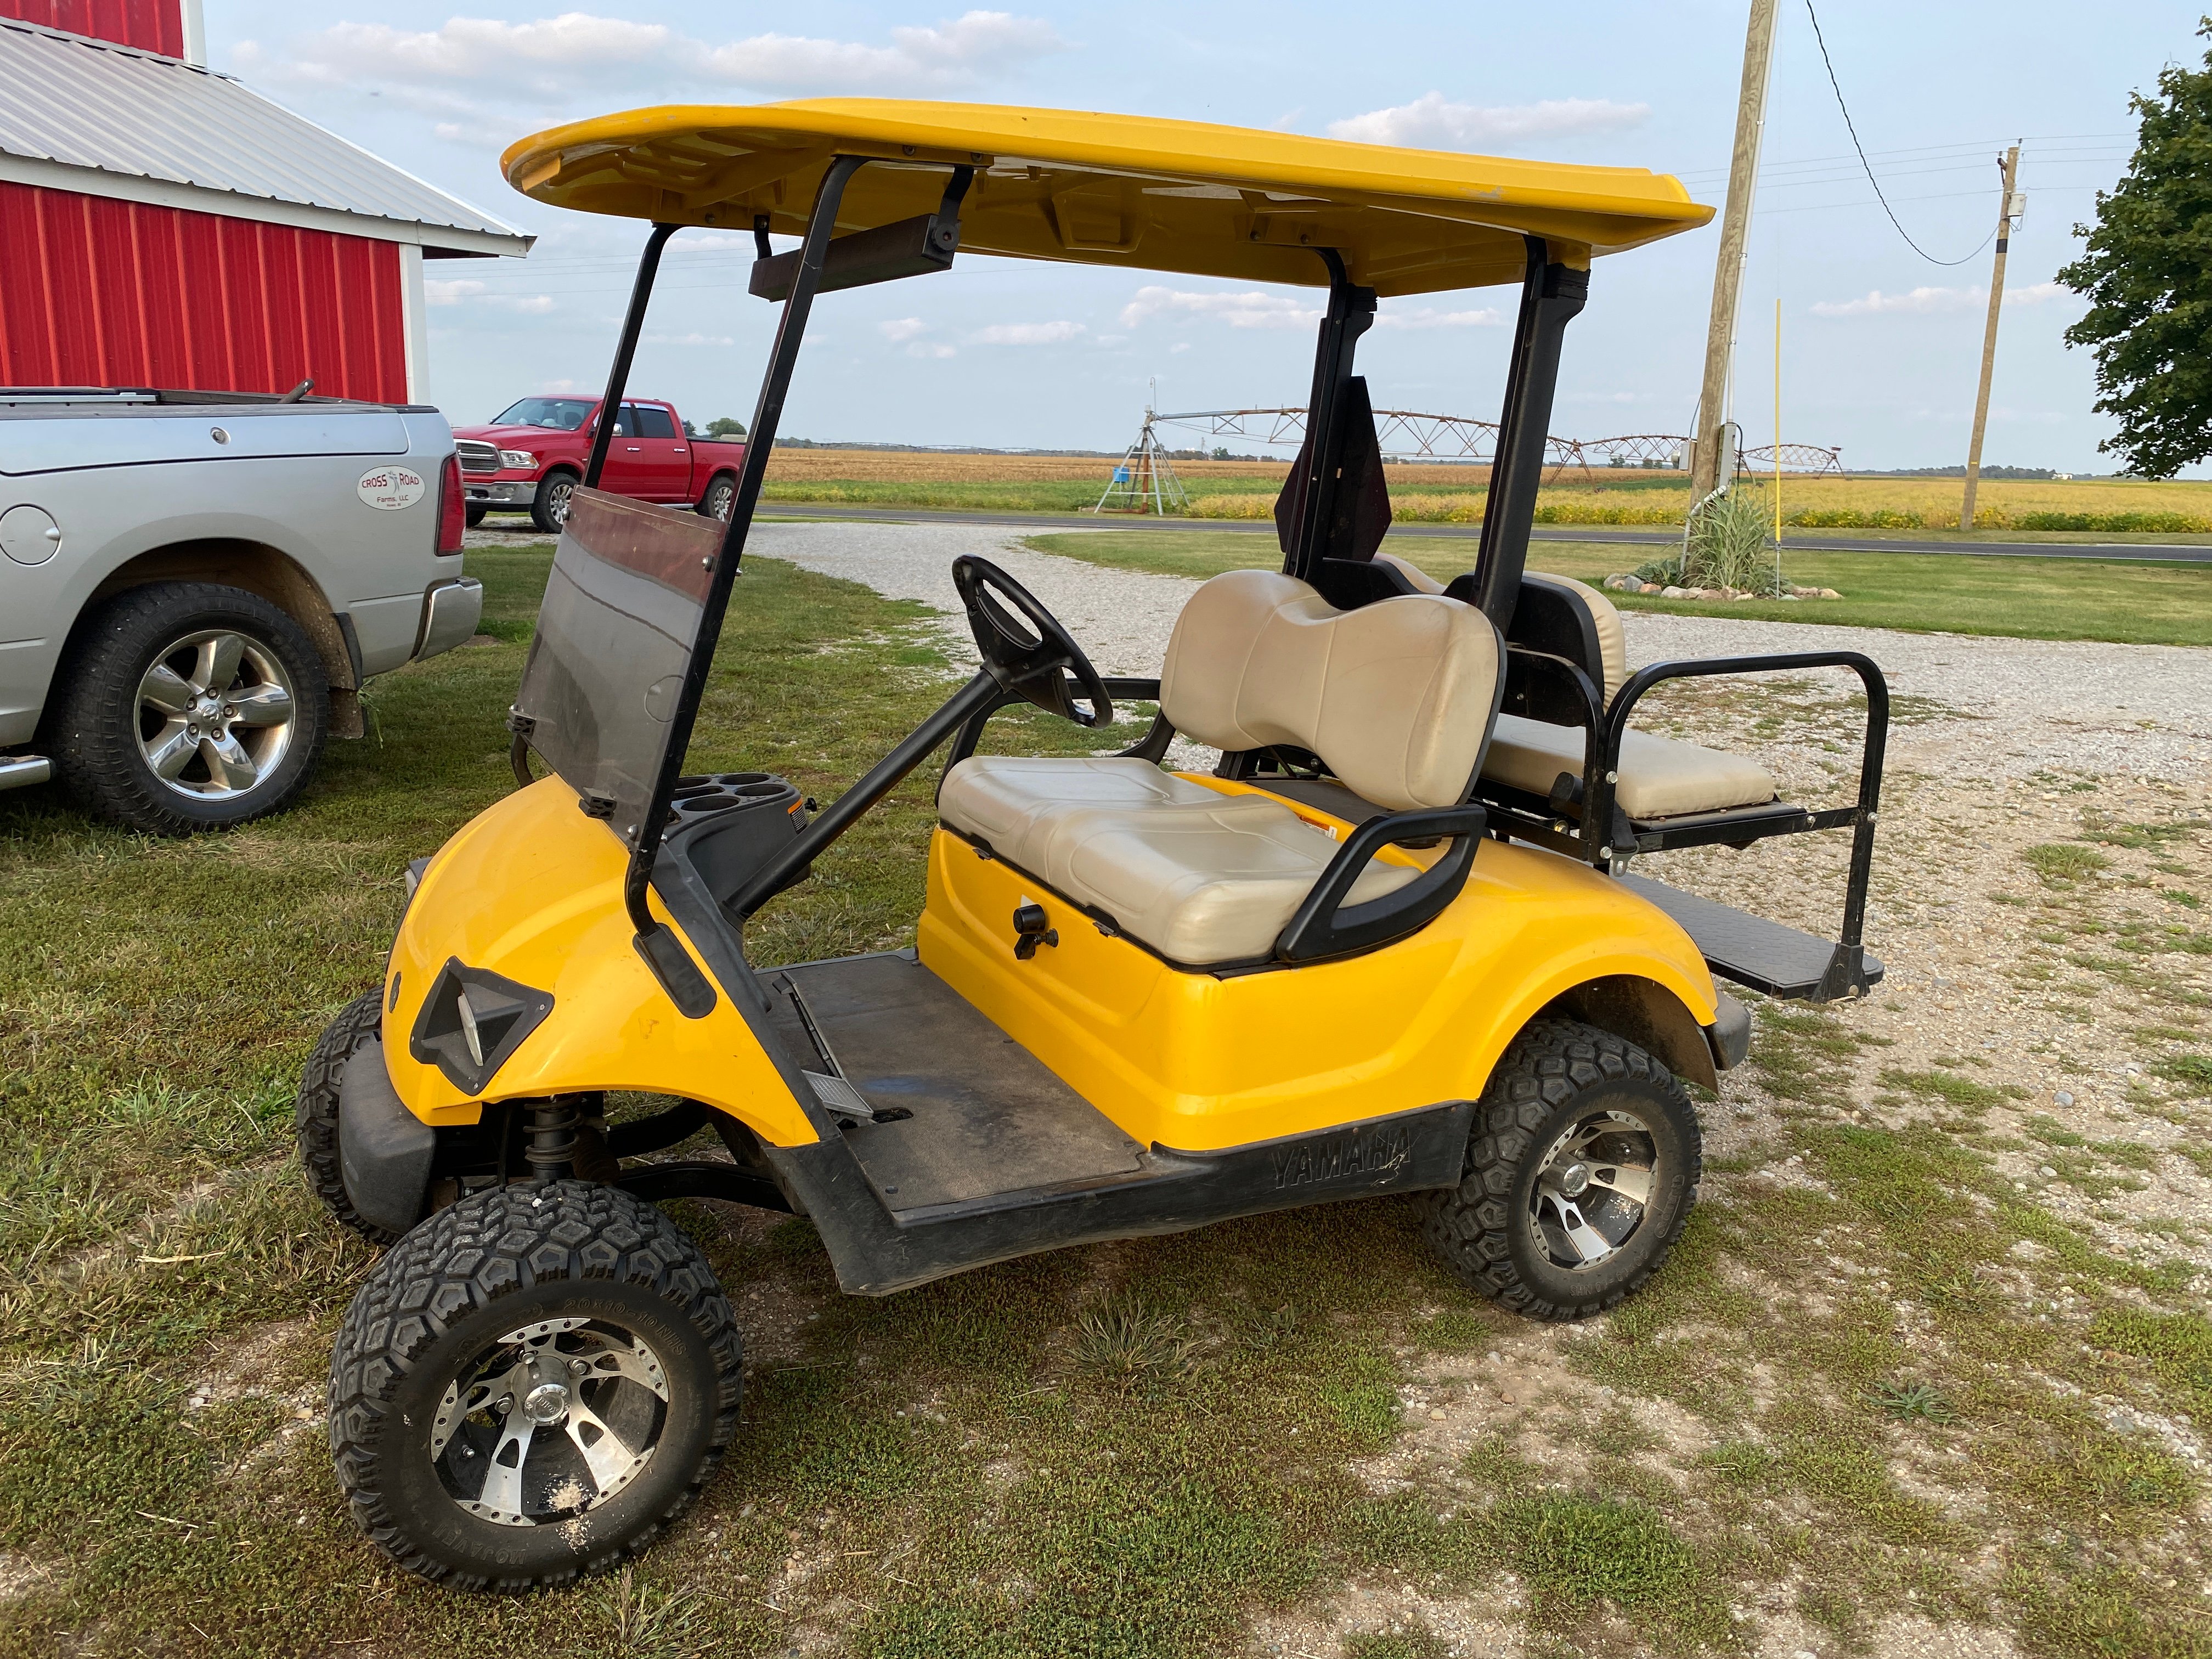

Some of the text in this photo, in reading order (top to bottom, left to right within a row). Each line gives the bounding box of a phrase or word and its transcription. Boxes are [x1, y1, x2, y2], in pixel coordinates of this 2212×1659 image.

[362, 473, 419, 488] CROSS ROAD
[1271, 1127, 1411, 1189] YAMAHA
[656, 1324, 687, 1356] NHS
[441, 1529, 527, 1566] MOJAVE
